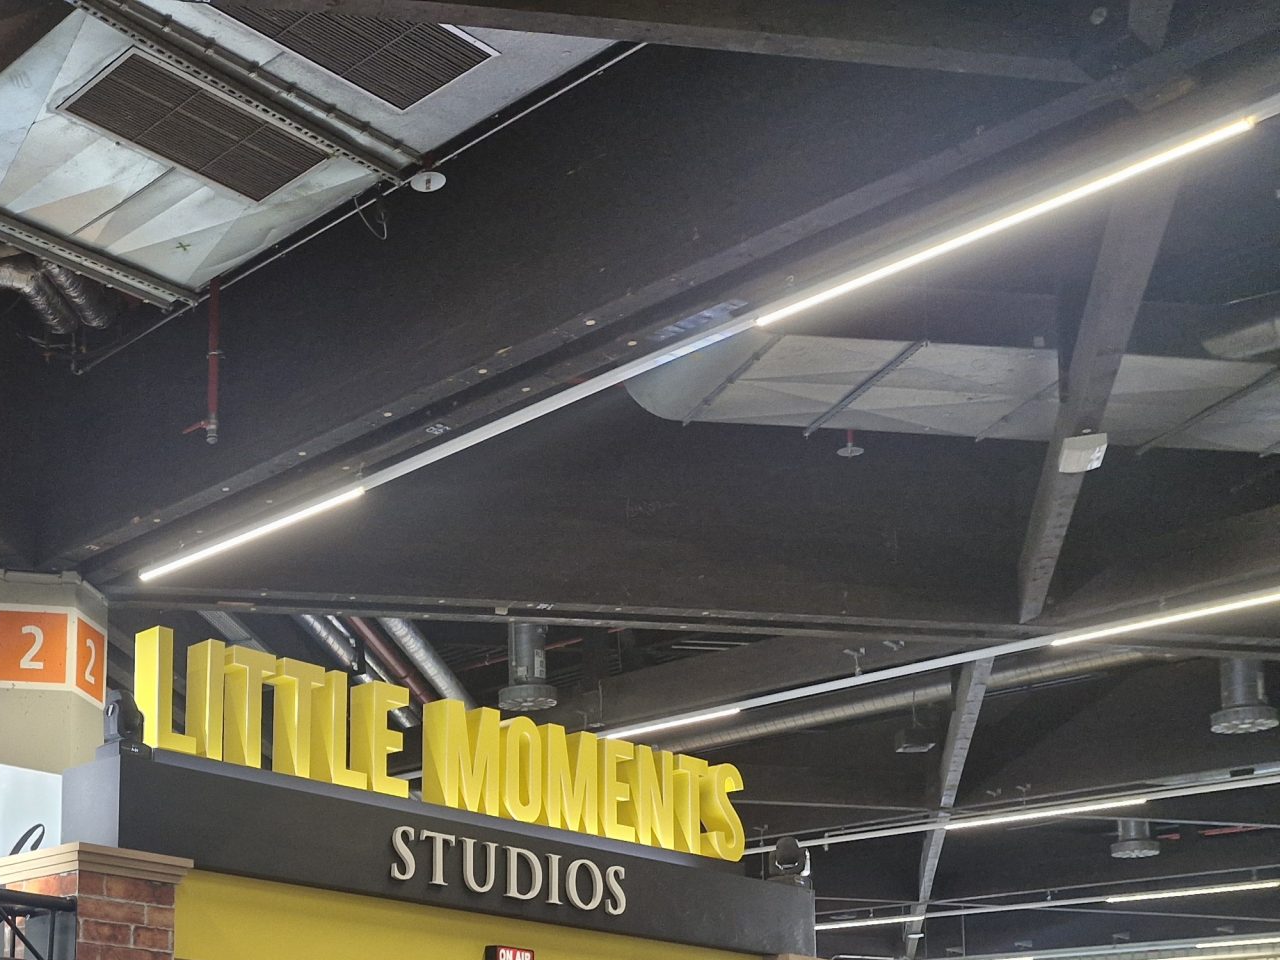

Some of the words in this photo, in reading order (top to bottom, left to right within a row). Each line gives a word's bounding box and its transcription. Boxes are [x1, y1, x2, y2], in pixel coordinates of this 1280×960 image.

[20, 625, 44, 669] 2
[84, 638, 96, 684] 2
[134, 625, 409, 799] LITTLE
[422, 698, 745, 862] MOMENTS
[390, 825, 627, 915] STUDIOS
